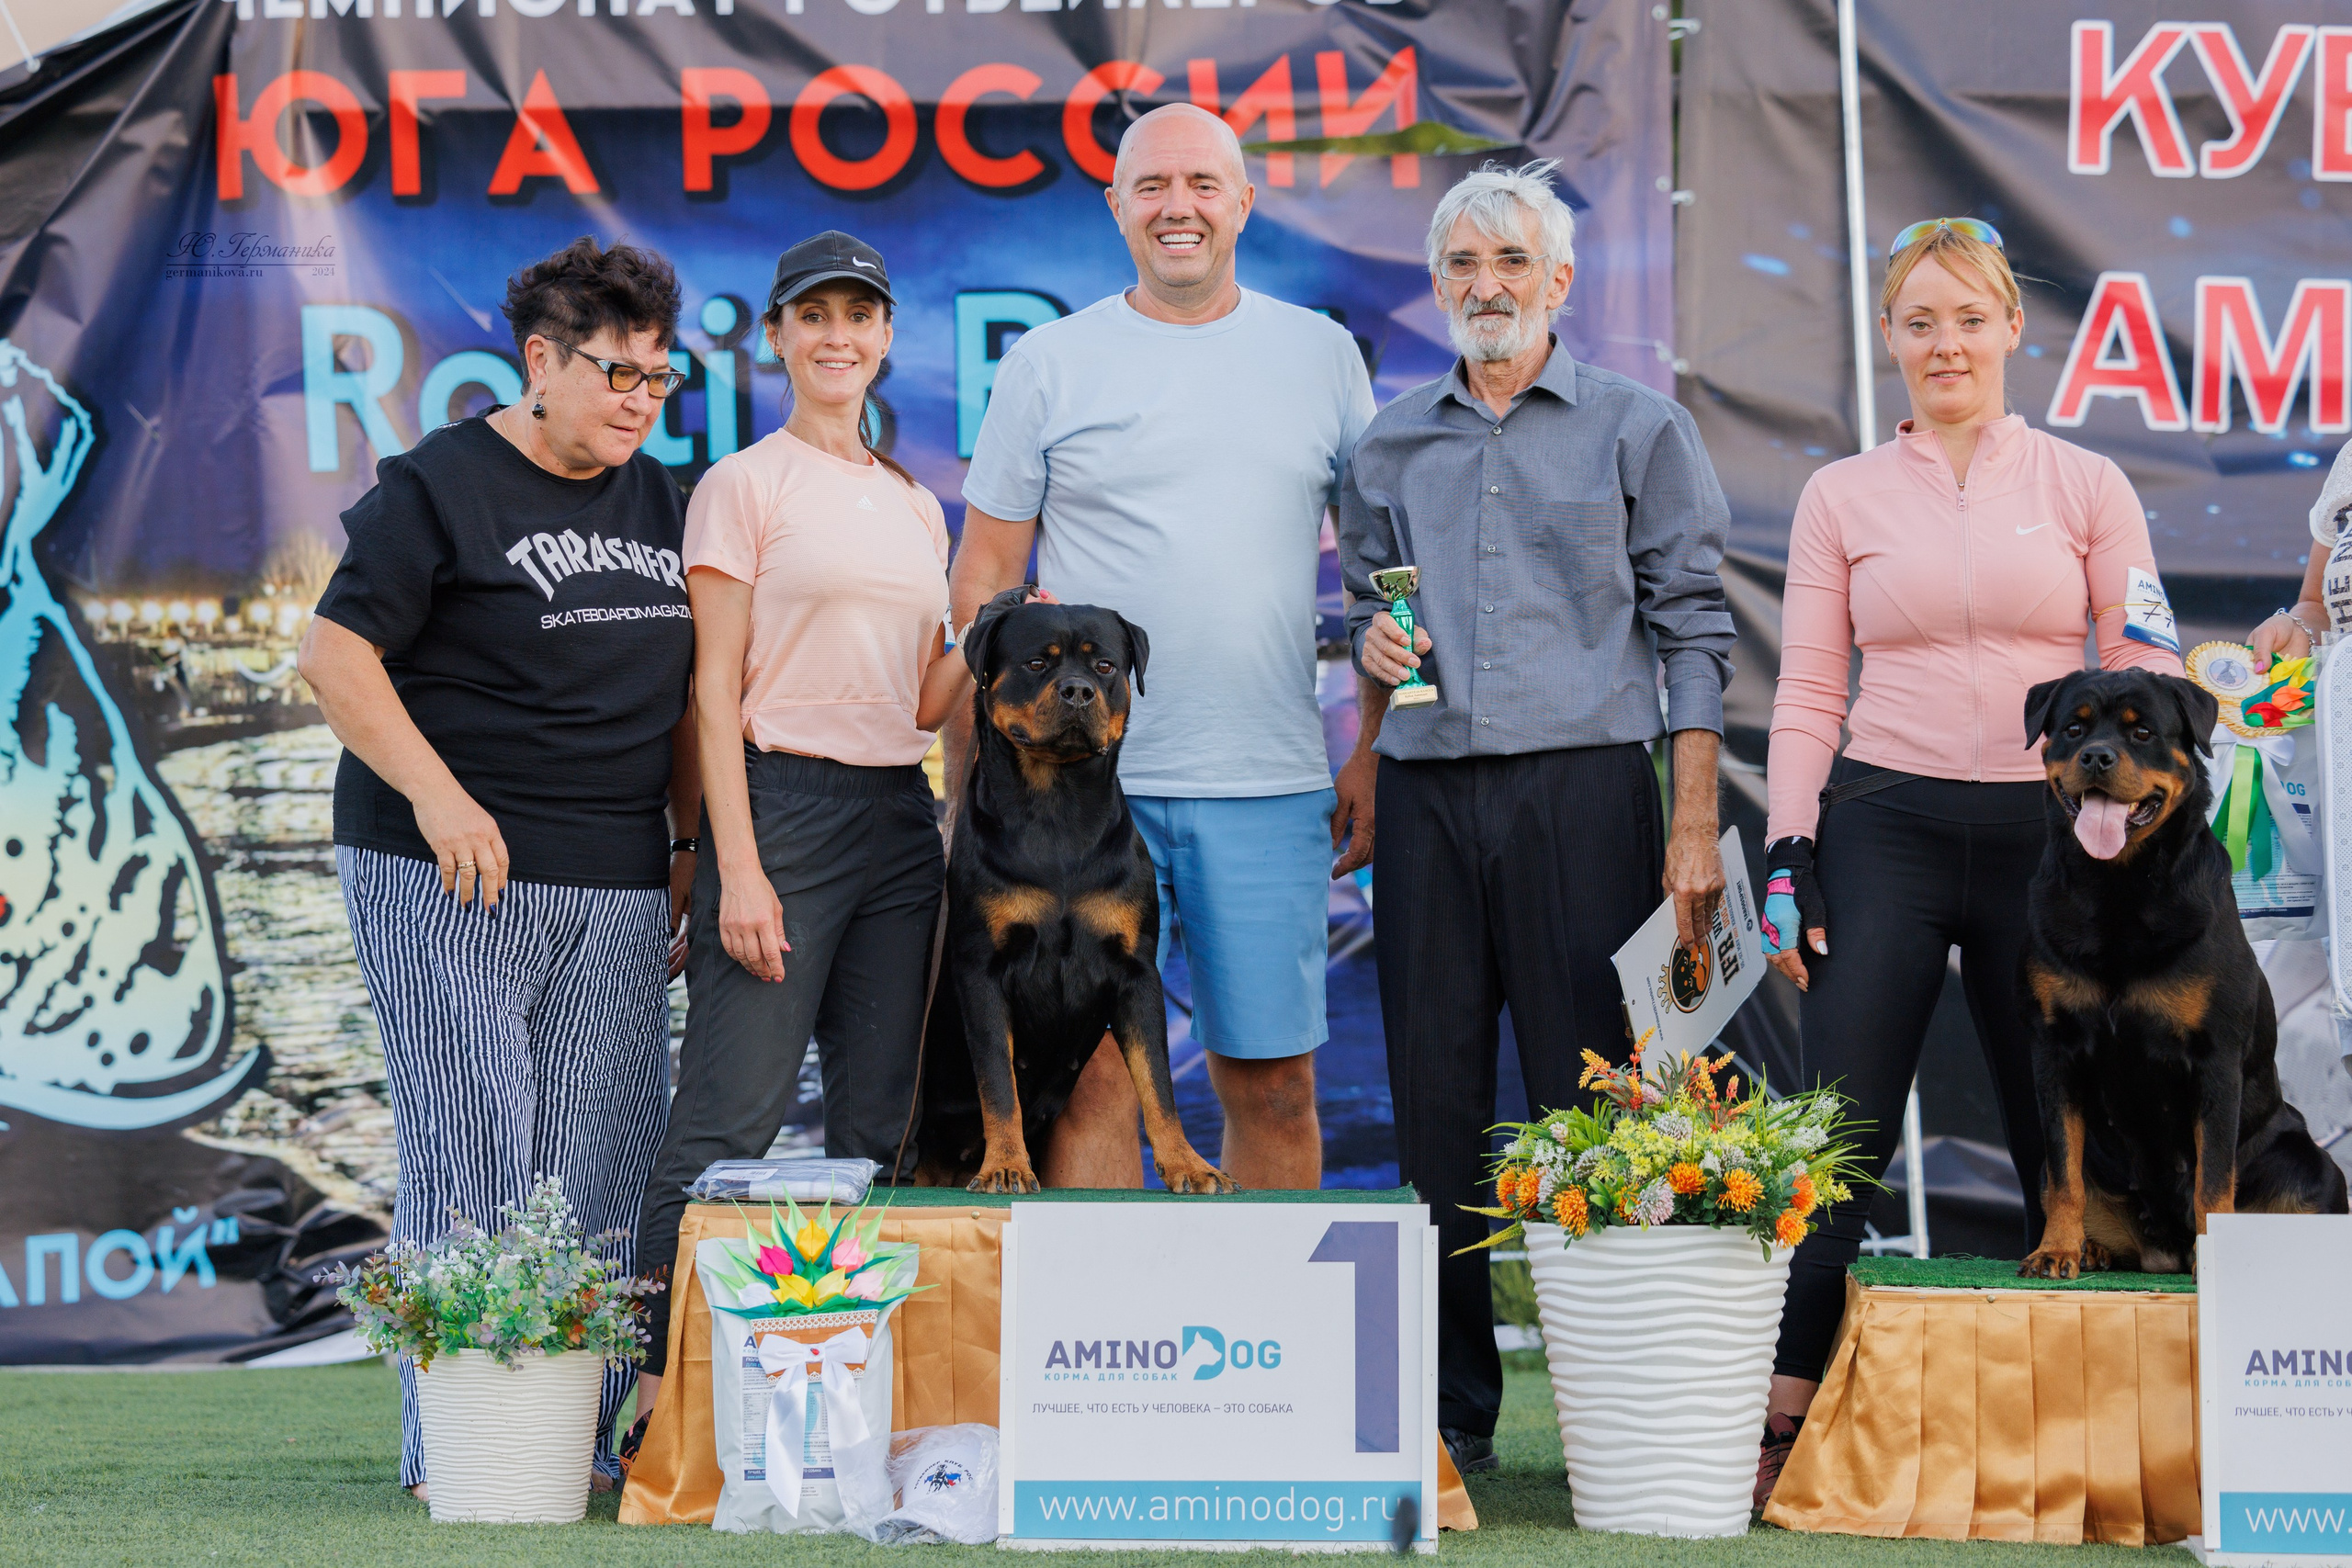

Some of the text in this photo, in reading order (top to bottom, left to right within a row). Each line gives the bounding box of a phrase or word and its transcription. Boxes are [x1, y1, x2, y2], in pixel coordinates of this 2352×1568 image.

[212, 46, 1420, 201] ЮГА РОССИИ
[1720, 907, 1732, 931] DOG
[1717, 929, 1741, 987] IFR
[1307, 1222, 1400, 1453] 1
[1044, 1372, 1178, 1382] КОРМА ДЛЯ СОБАК
[2245, 1379, 2288, 1388] КОРМА
[2294, 1379, 2320, 1388] ДЛЯ
[1032, 1403, 1083, 1415] ЛУЧШЕЕ,
[1087, 1403, 1109, 1414] ЧТО
[1112, 1403, 1139, 1414] ЕСТЬ
[1142, 1403, 1149, 1414] У
[1152, 1403, 1211, 1414] ЧЕЛОВЕКА
[1223, 1403, 1245, 1414] ЭТО
[1248, 1403, 1294, 1414] СОБАКА
[2234, 1406, 2282, 1417] ЛУЧШЕЕ,
[2285, 1406, 2306, 1417] ЧТО
[2308, 1406, 2335, 1417] ЕСТЬ
[2336, 1406, 2344, 1417] У
[1038, 1485, 1402, 1532] www.aminodog.ru
